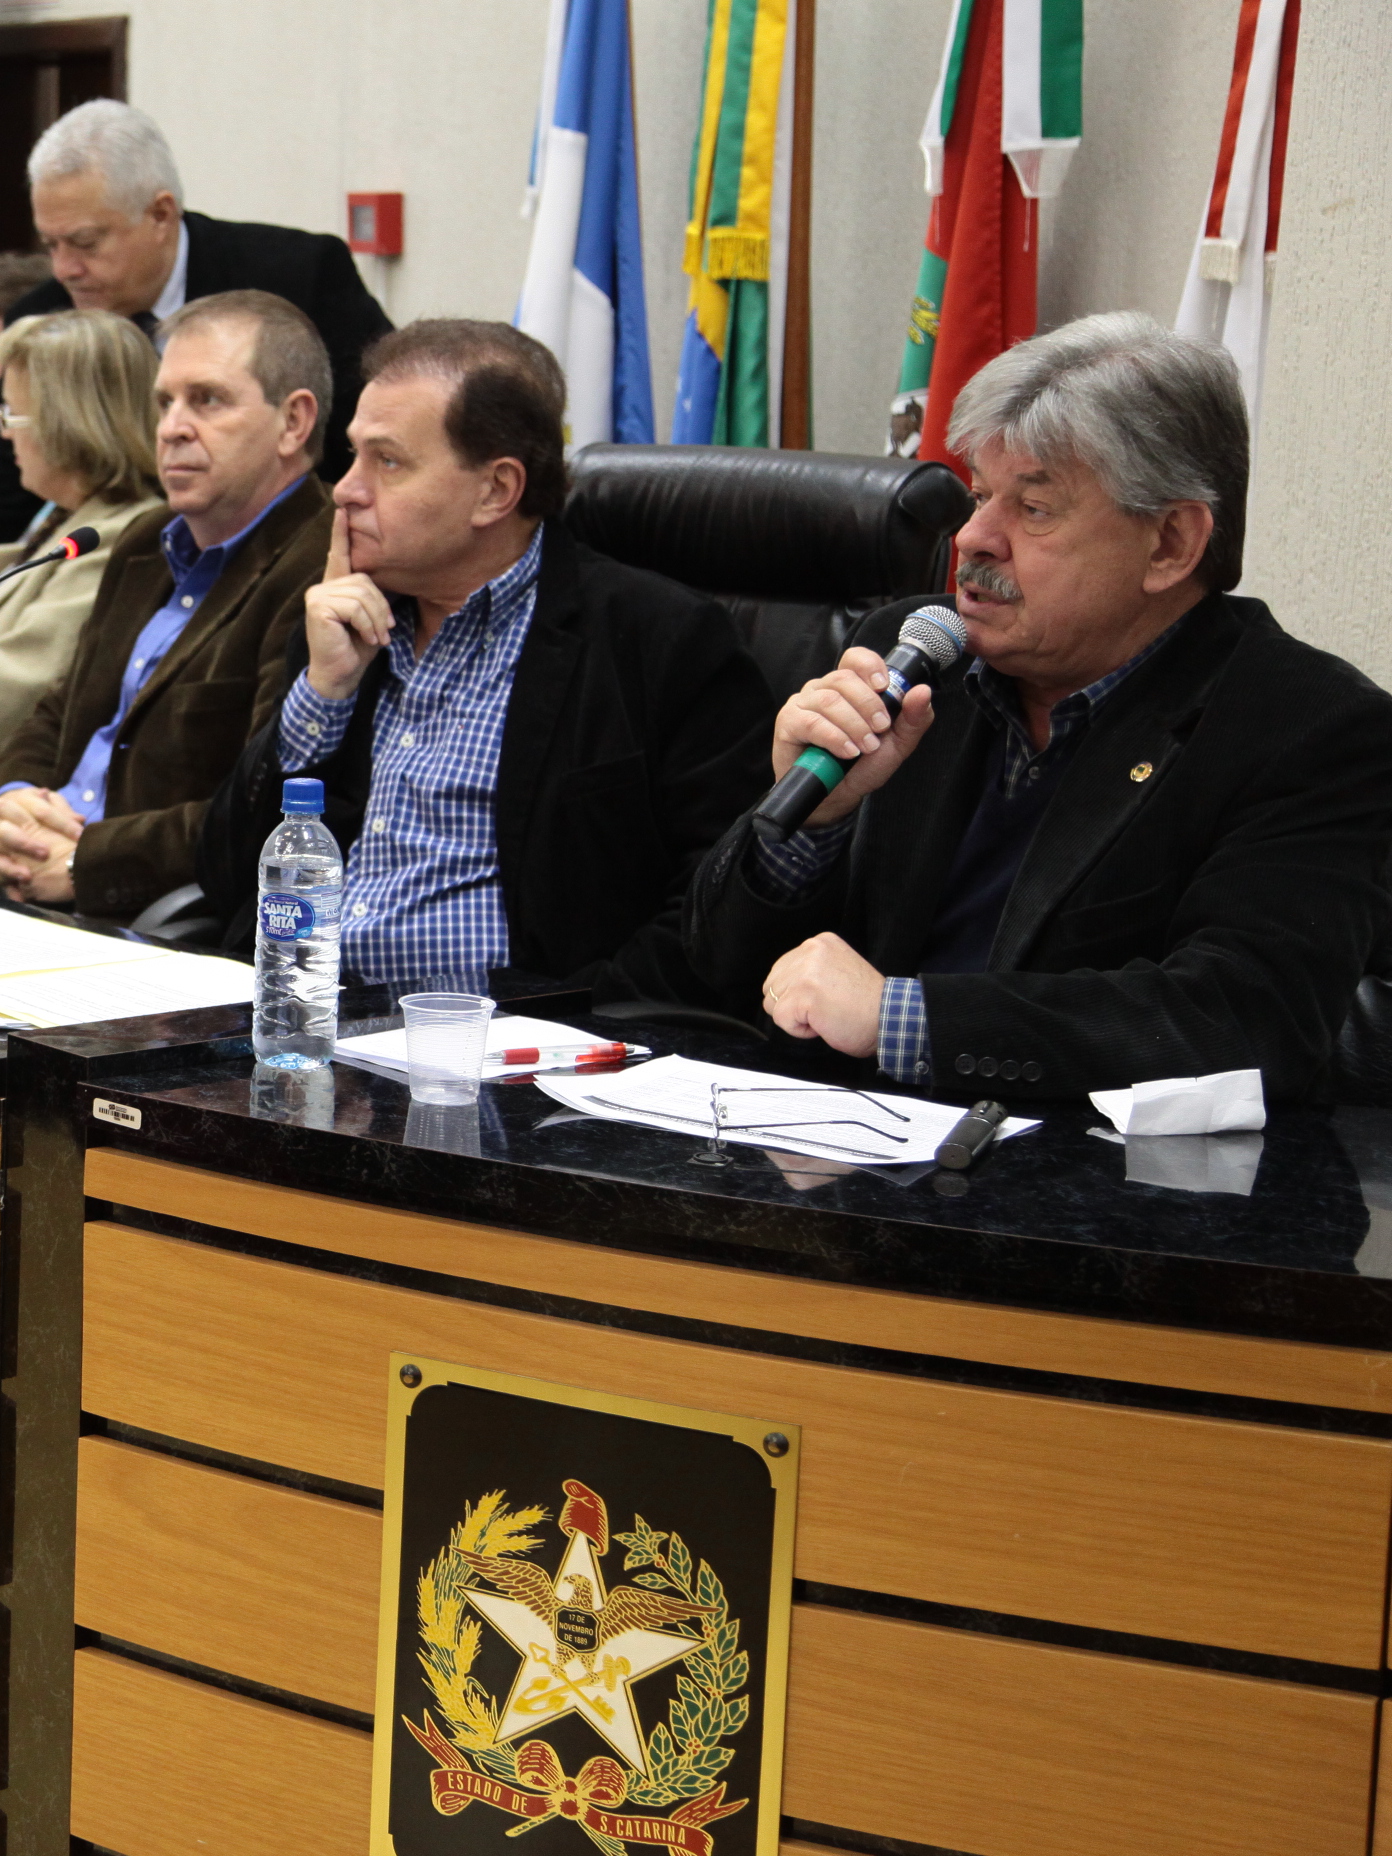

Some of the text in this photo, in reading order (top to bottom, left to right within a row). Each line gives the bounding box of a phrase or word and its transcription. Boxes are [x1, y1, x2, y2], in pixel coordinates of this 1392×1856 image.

[264, 902, 303, 919] SANTA
[269, 914, 297, 930] RITA
[577, 1615, 586, 1623] DE
[559, 1621, 594, 1636] NOVEMBRO
[564, 1633, 588, 1645] DE 1889
[447, 1771, 528, 1815] ESTADO DE
[599, 1815, 687, 1846] S. CATARINA
